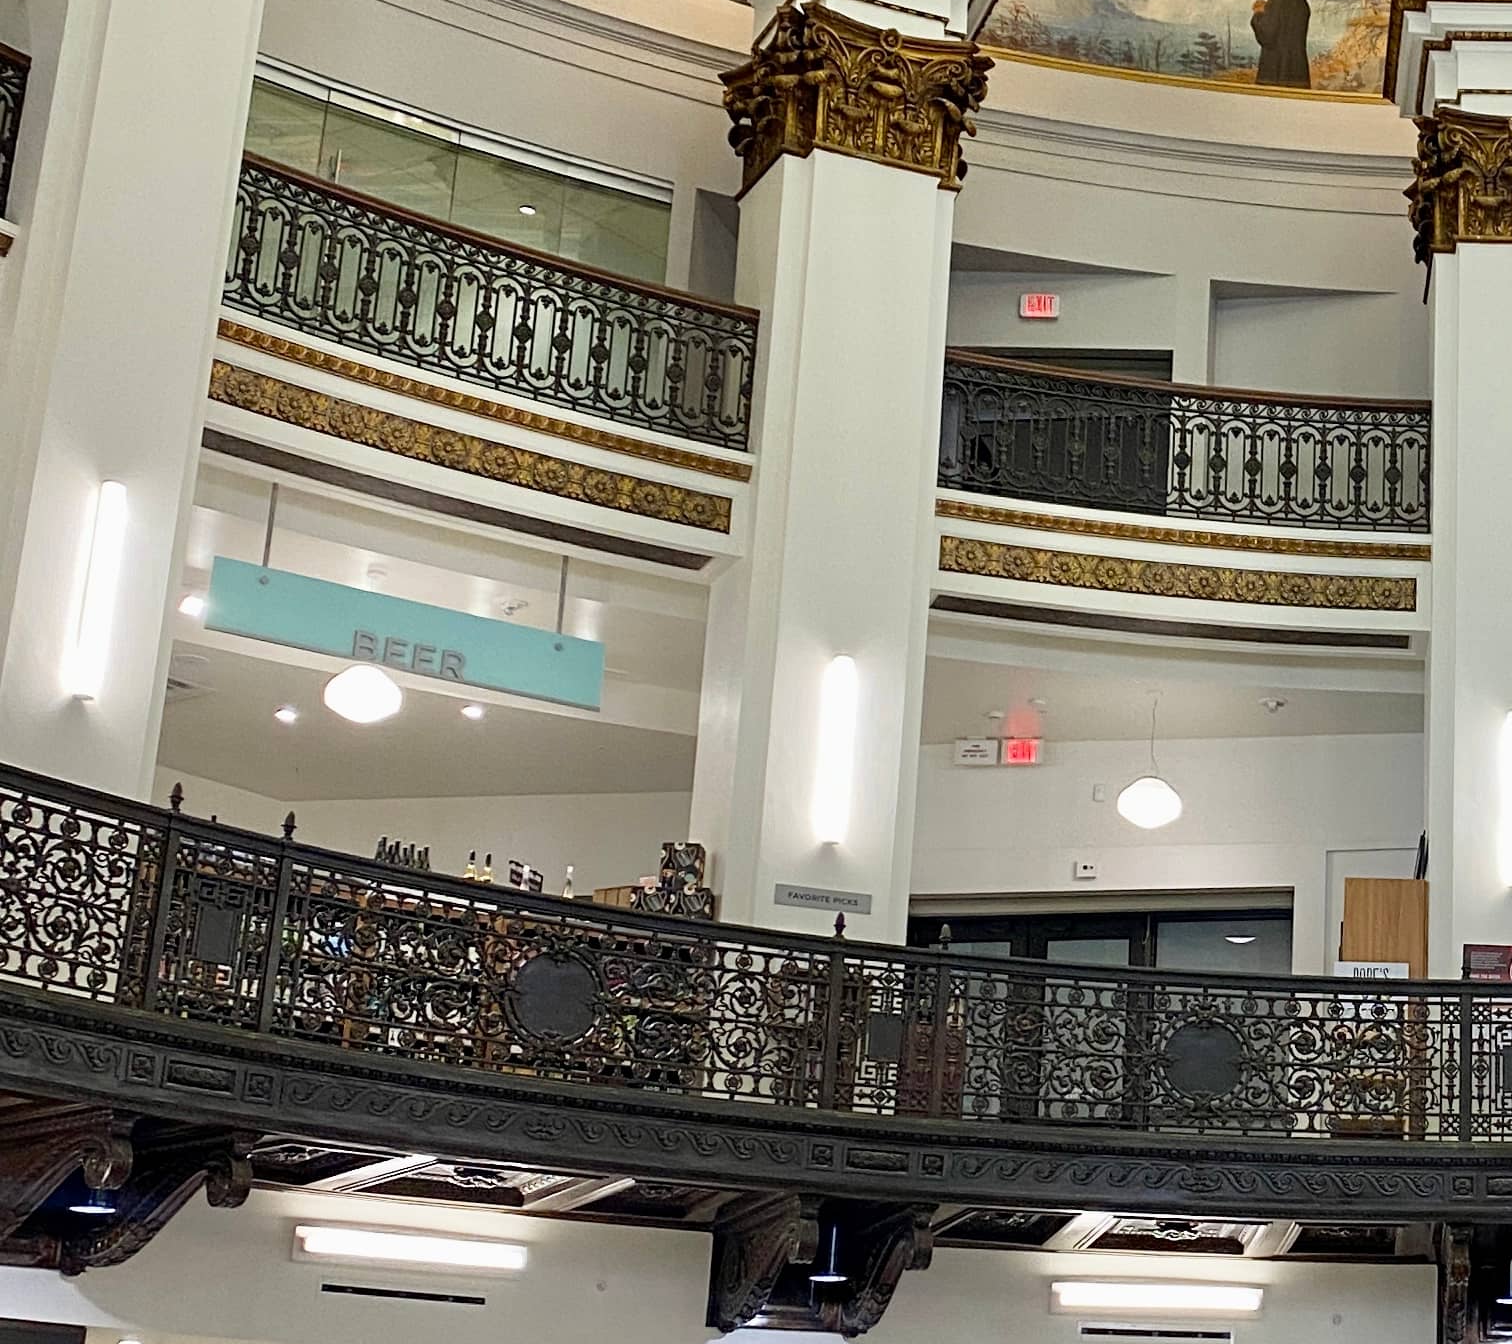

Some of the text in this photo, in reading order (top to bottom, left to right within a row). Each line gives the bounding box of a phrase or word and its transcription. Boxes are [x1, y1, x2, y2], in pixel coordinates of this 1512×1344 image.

[352, 629, 465, 682] BEER
[788, 891, 859, 907] FAVORITE PICKS
